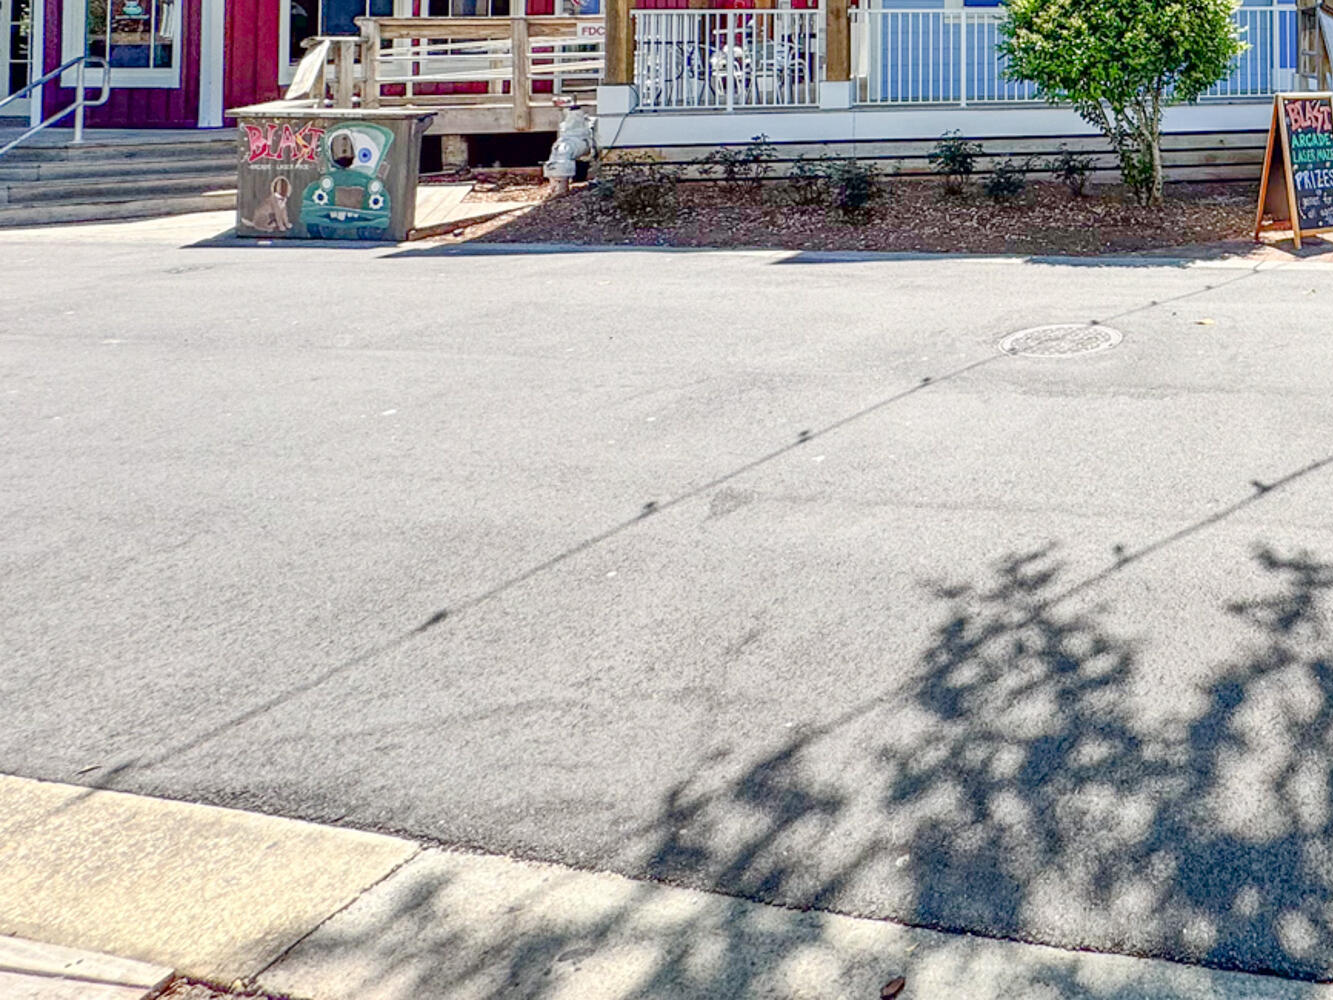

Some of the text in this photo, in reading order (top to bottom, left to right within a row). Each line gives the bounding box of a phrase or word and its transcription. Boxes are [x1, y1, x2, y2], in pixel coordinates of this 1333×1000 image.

[1286, 100, 1331, 133] BLAST
[244, 122, 326, 166] BLAST
[1291, 132, 1331, 149] ARCADE
